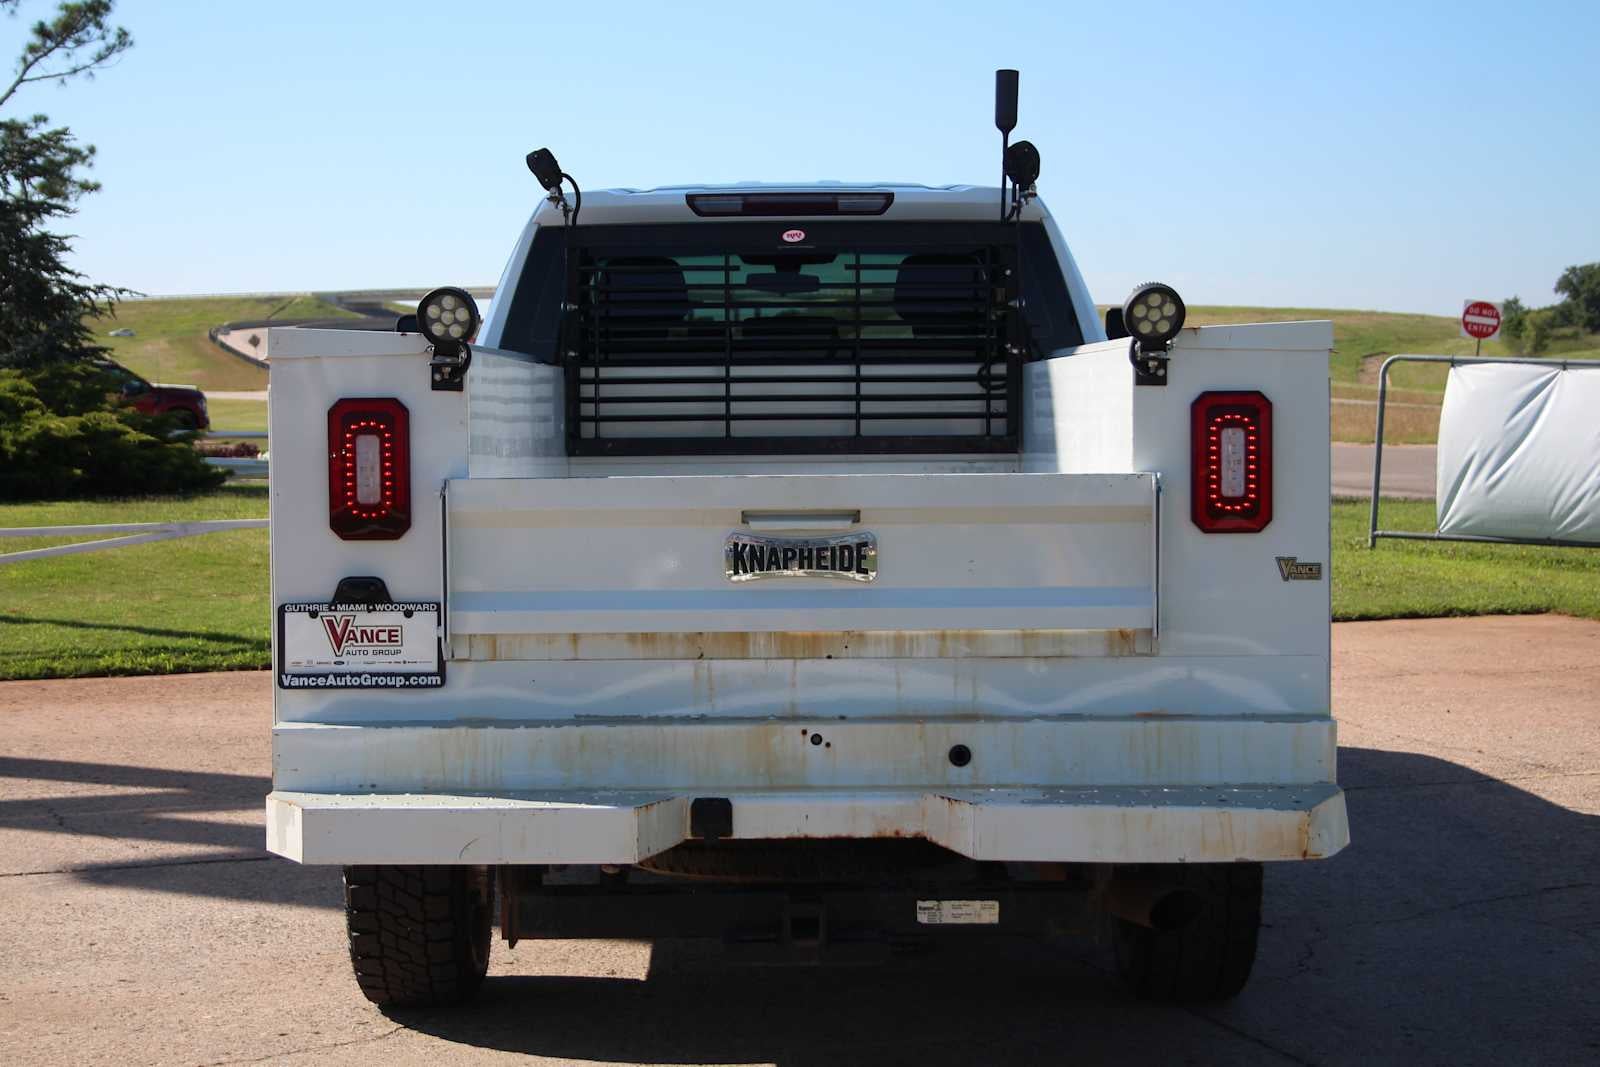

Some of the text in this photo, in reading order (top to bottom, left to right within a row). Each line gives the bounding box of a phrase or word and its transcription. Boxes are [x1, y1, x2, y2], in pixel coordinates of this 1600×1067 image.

[732, 540, 869, 576] KNAPHEIDE
[285, 603, 438, 612] GUTHRIE MIAMI WOODWARD
[325, 618, 400, 653] VANCE
[281, 674, 441, 687] VanceAutoGroup.com
